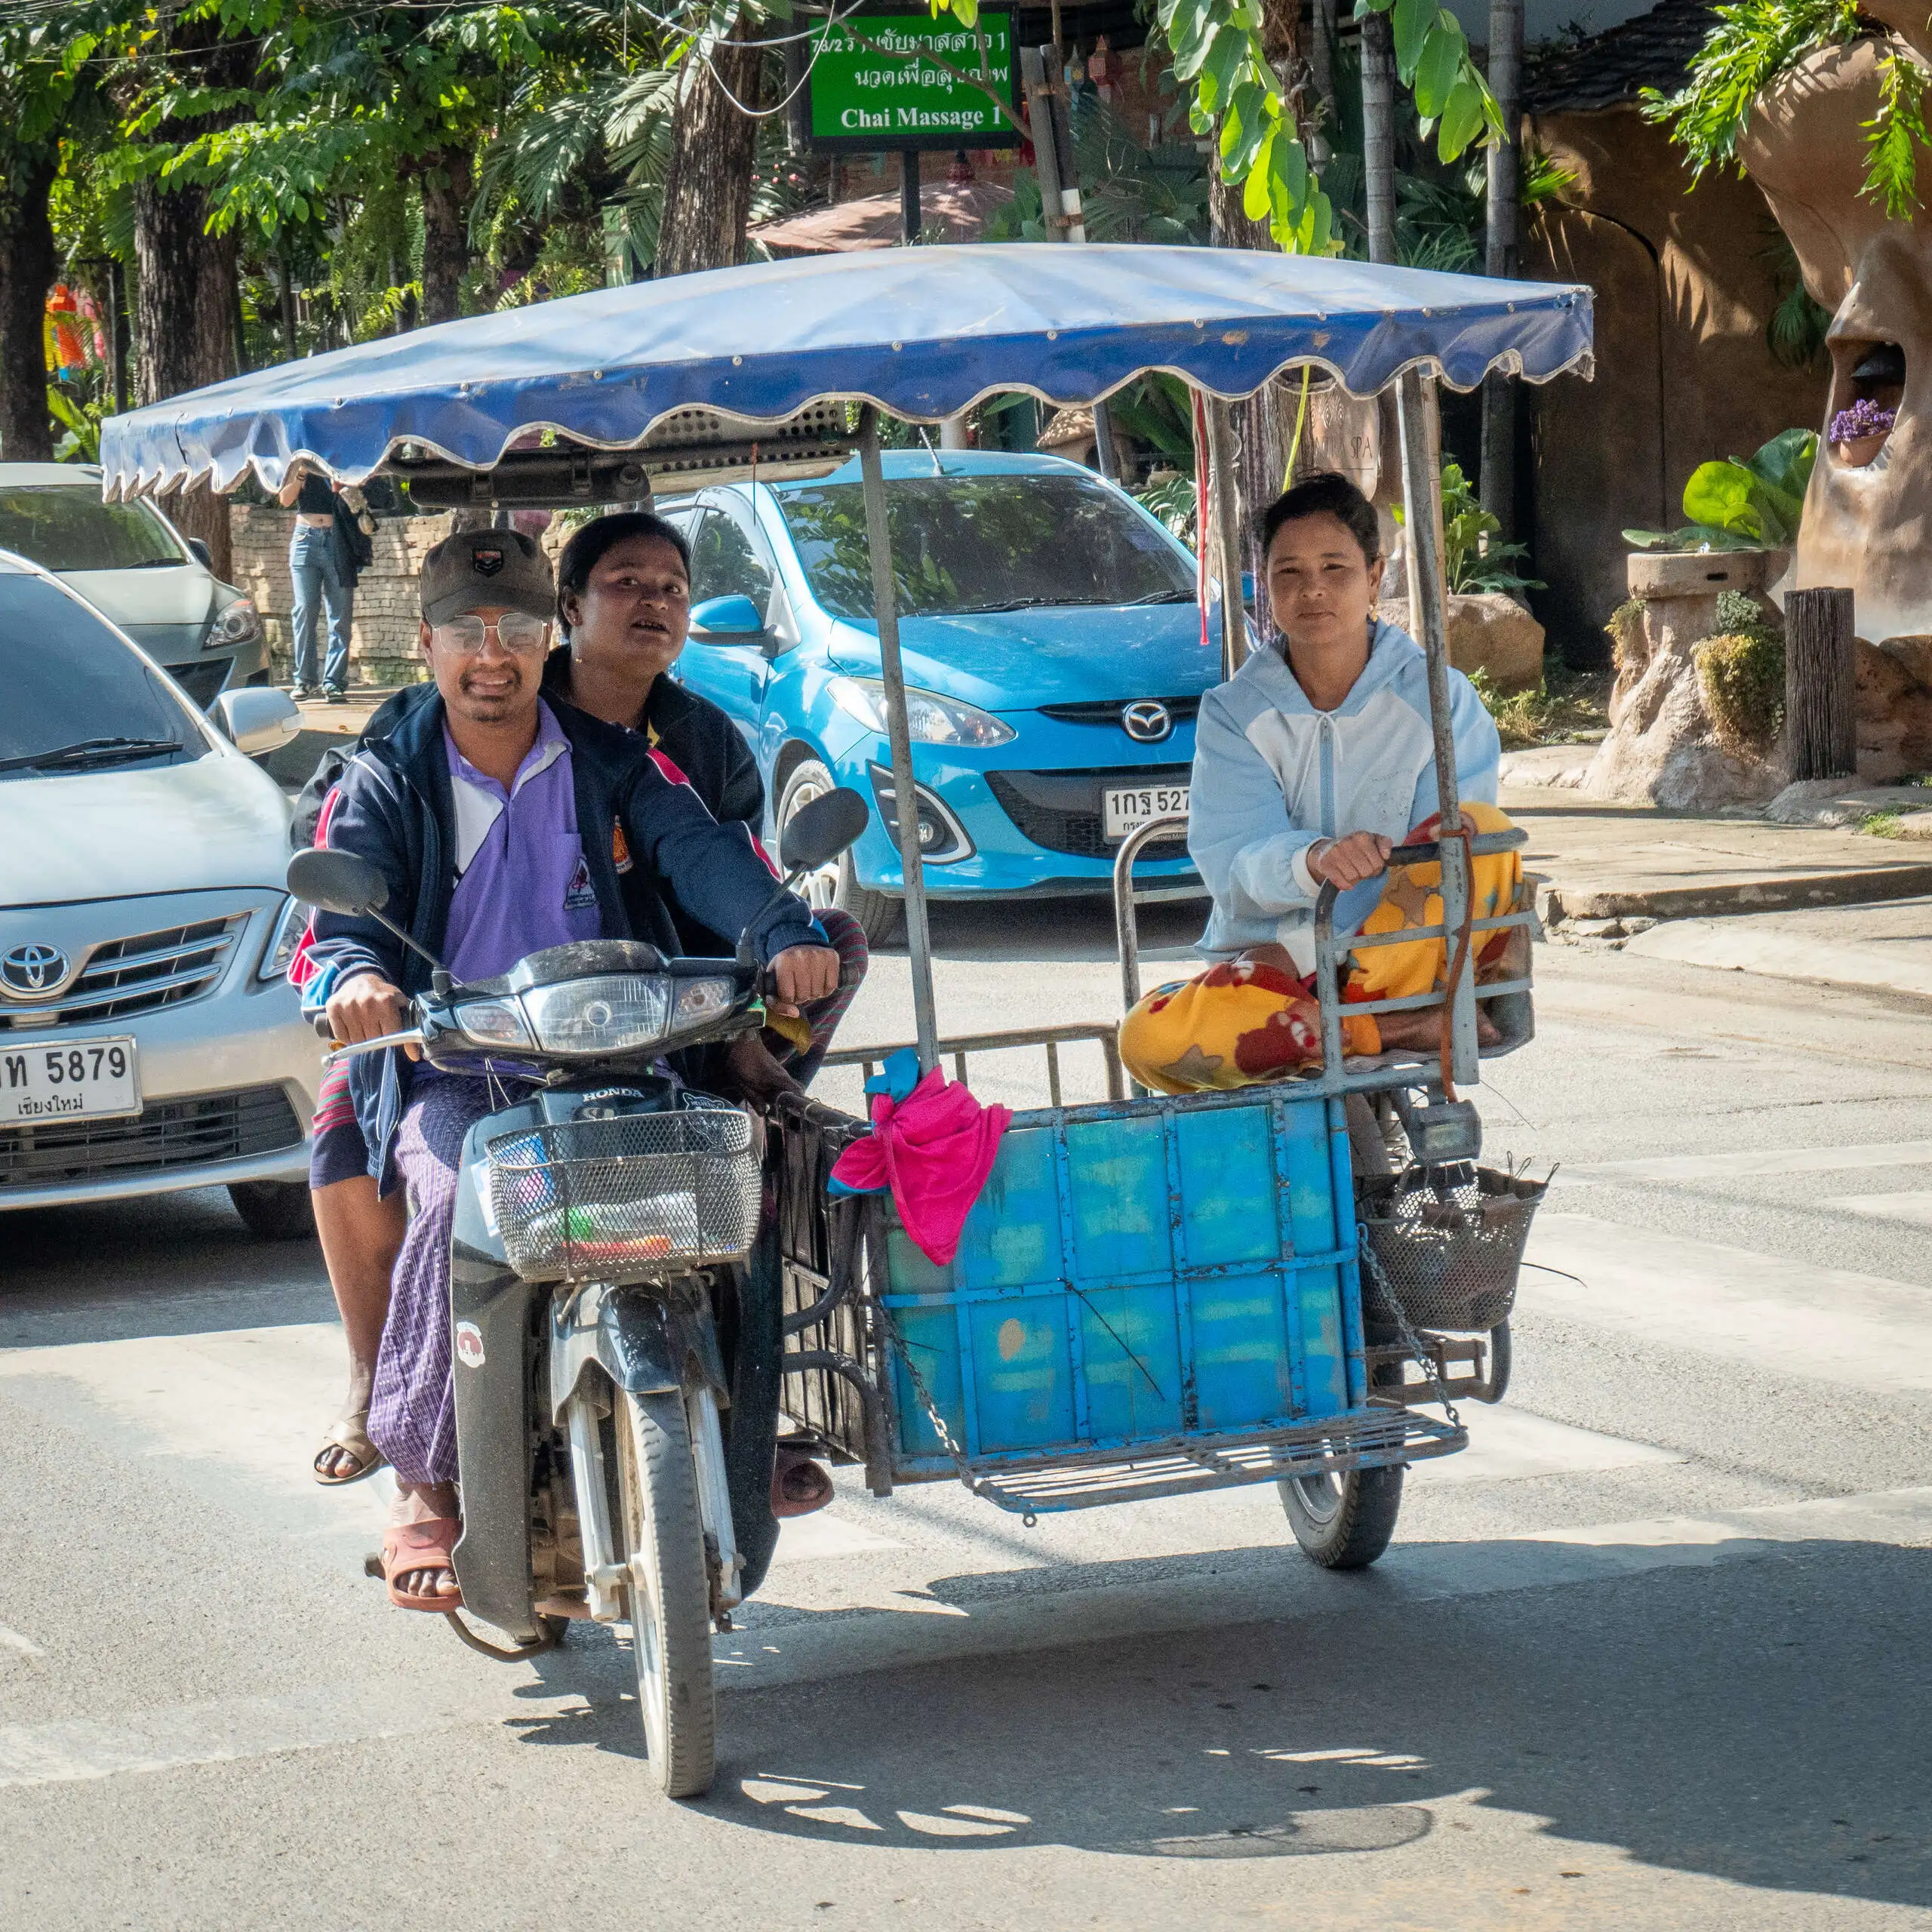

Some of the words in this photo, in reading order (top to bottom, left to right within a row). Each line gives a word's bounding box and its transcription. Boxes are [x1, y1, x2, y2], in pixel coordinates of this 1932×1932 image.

[841, 108, 891, 128] Chai
[897, 107, 984, 130] Massage
[992, 106, 1001, 125] 1
[1351, 436, 1373, 459] SPA
[1112, 792, 1152, 816] 1กฐ
[0, 1054, 28, 1088] ท
[46, 1046, 126, 1084] 5879
[18, 1093, 84, 1115] เชียงใหม่
[583, 1088, 645, 1103] HONDA
